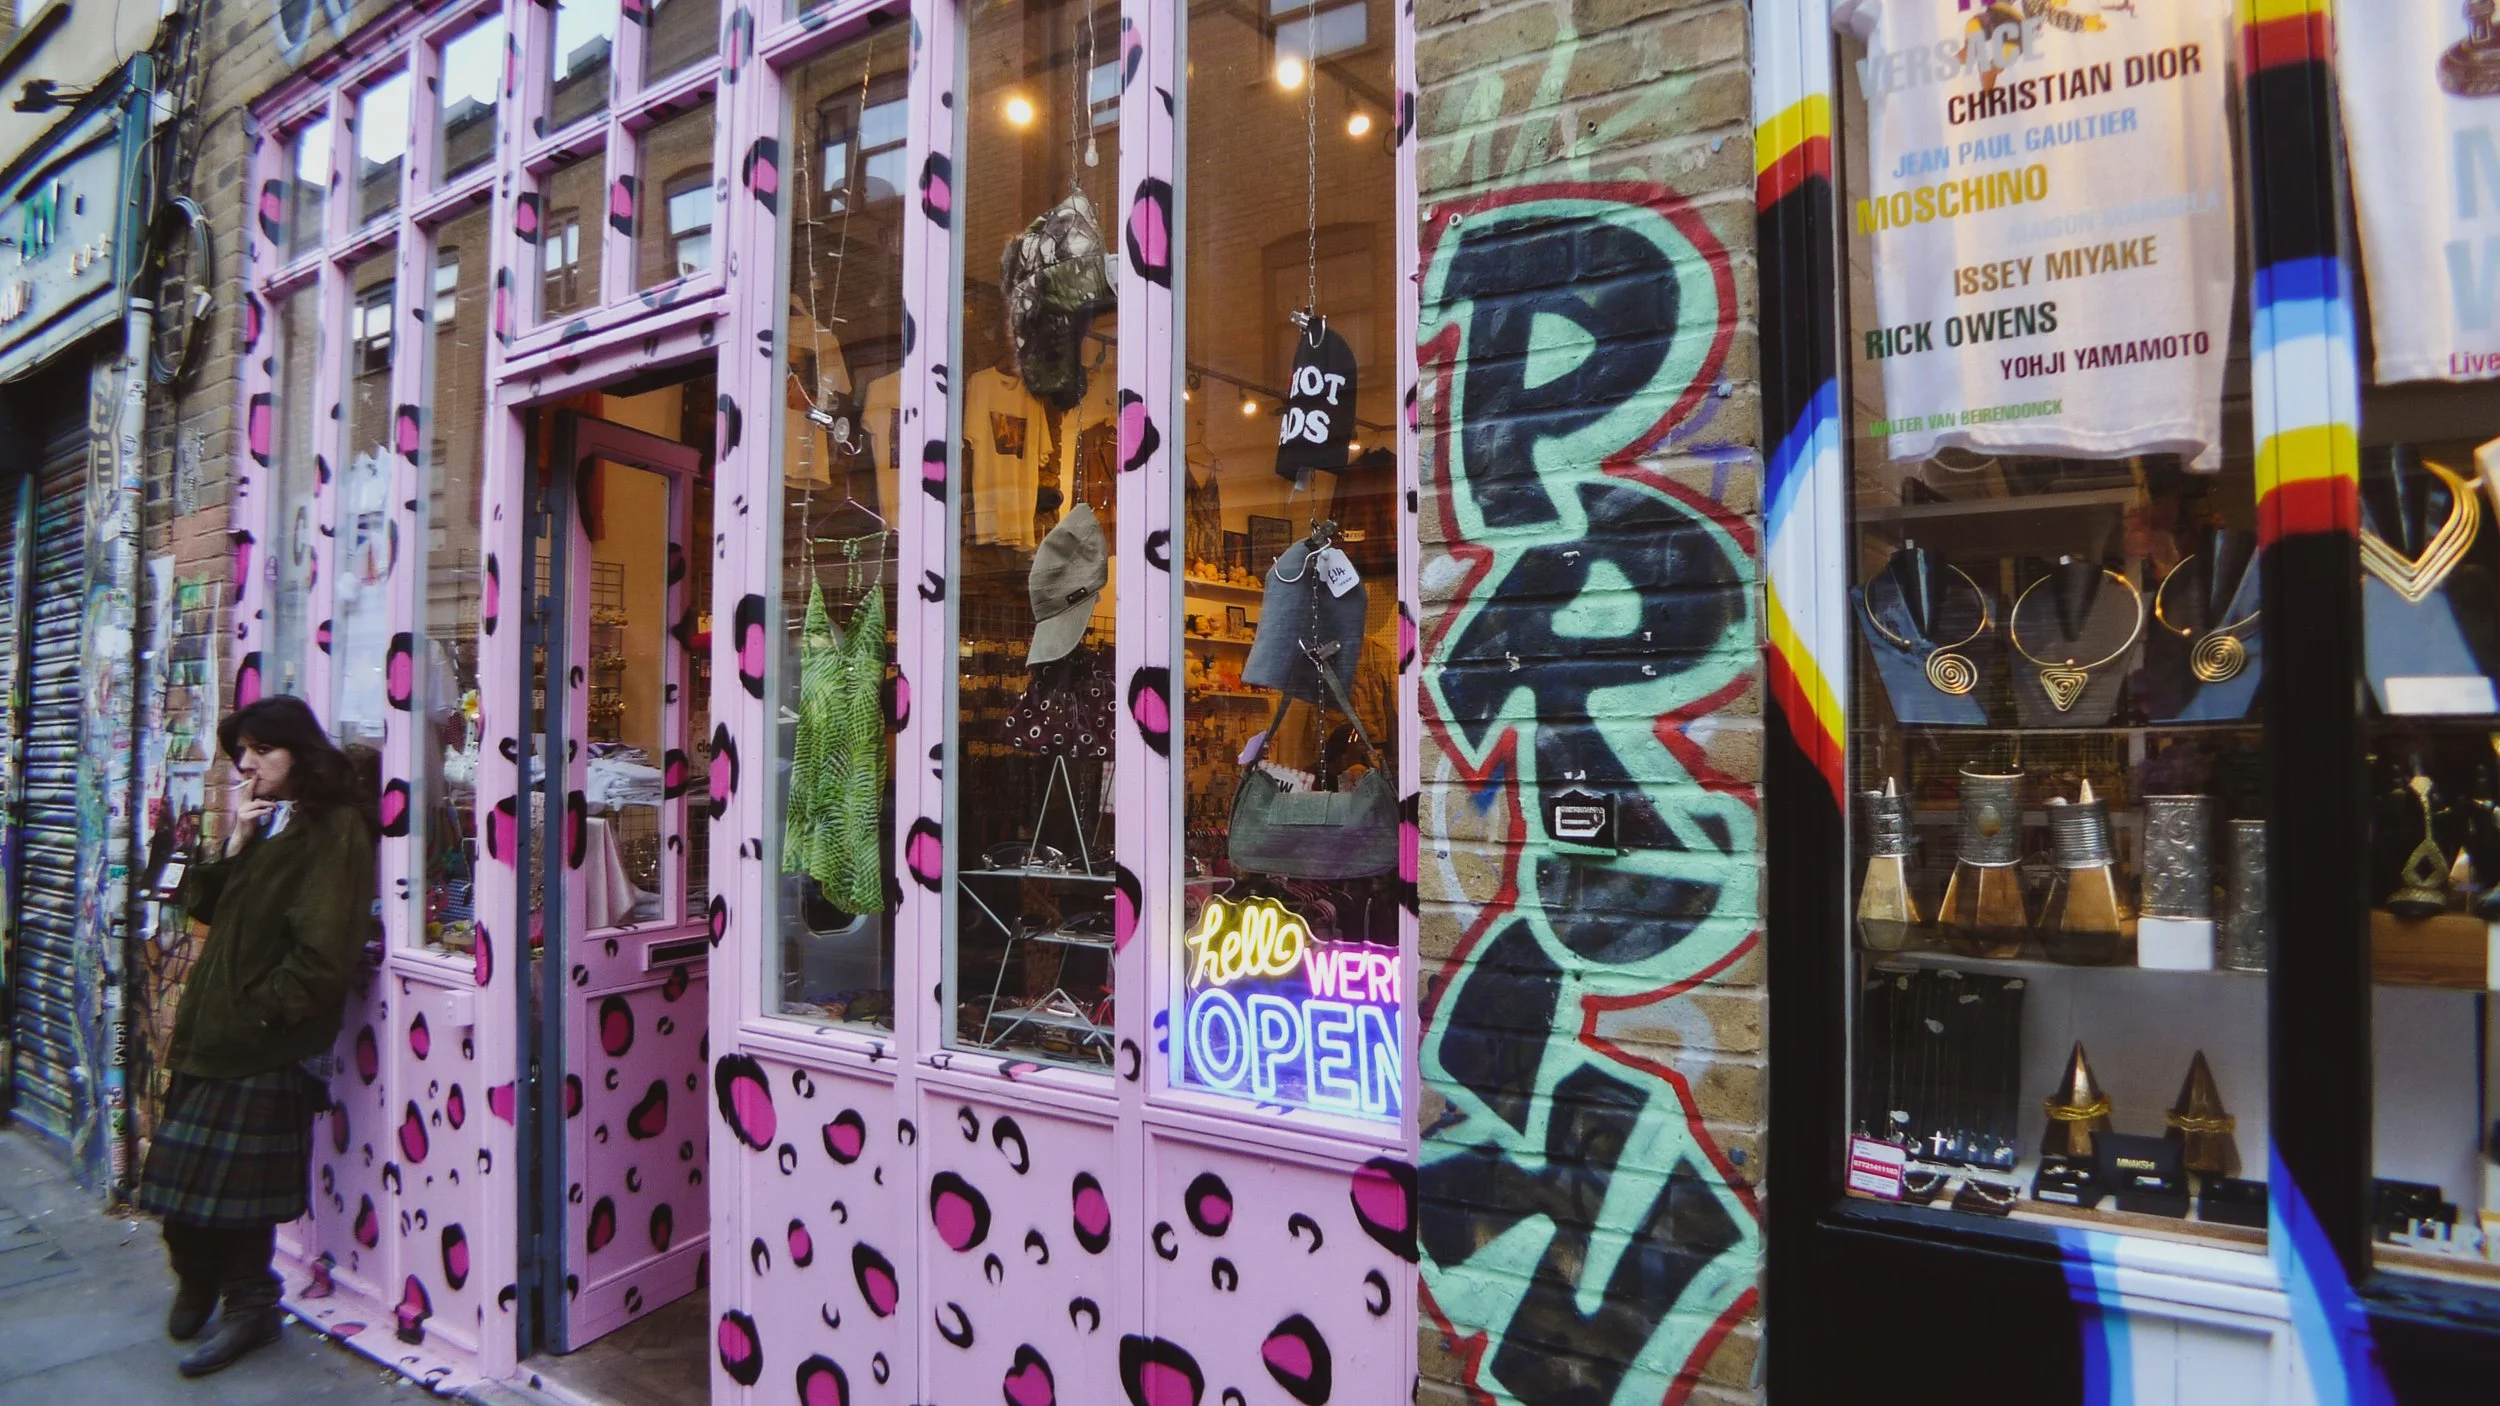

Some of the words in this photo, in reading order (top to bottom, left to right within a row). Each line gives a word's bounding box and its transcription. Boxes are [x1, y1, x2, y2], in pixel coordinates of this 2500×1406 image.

[1856, 16, 2044, 100] VERSACE
[1947, 62, 2112, 126] CHRISTIAN
[2124, 44, 2203, 89] DIOR
[1892, 145, 1951, 180] JEAN
[1958, 133, 2017, 166] PAUL
[2024, 107, 2138, 152] GAULTIER
[1856, 163, 2049, 237] MOSCHINO
[1953, 255, 2034, 297] ISSEY
[2044, 235, 2159, 283] MIYAKE
[1865, 320, 1935, 361] RICK
[1944, 300, 2058, 349] OWENS
[2000, 350, 2066, 380] YOHJI
[2073, 330, 2211, 372] YAMAMOTO
[1868, 416, 1924, 438] WALTER
[1928, 411, 1956, 431] VAN
[1960, 398, 2063, 426] BEIRENDONCK
[1188, 903, 1305, 989] hello
[1188, 987, 1400, 1115] OPEN
